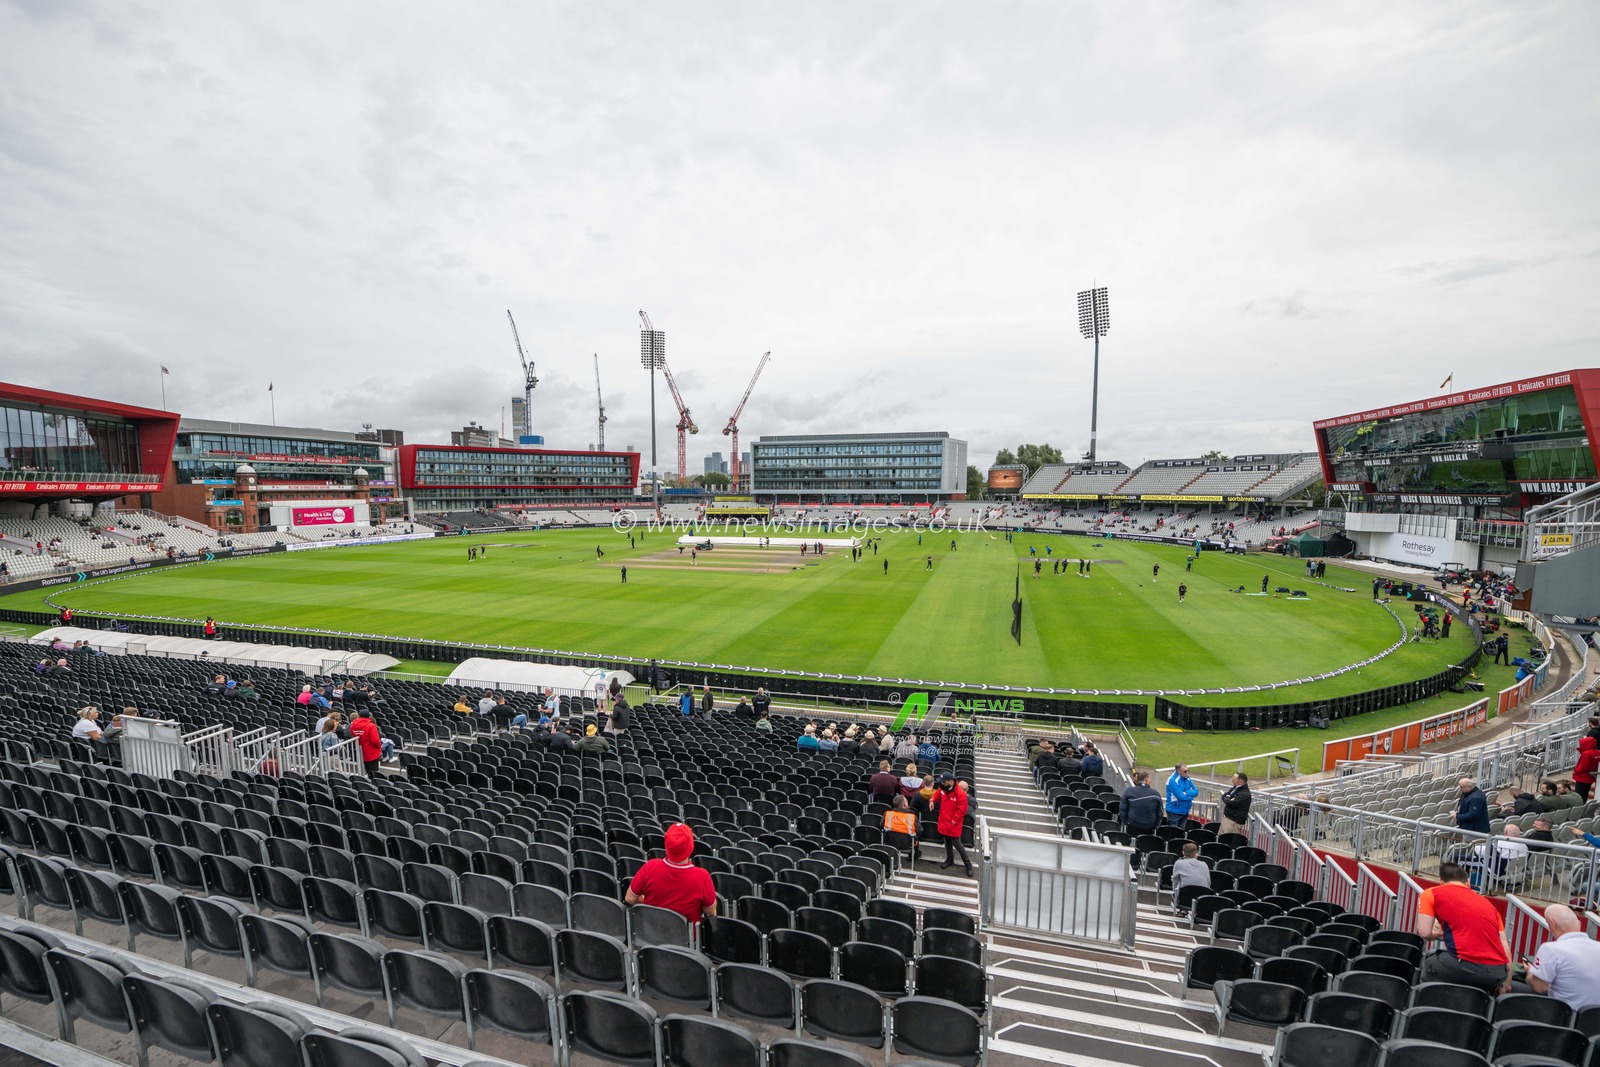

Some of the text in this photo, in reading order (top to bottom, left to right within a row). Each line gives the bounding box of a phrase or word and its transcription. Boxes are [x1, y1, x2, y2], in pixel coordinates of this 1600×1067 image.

[1518, 380, 1544, 391] Emirates
[1555, 374, 1570, 384] BETTER
[1468, 391, 1491, 400] Emirates
[1500, 386, 1512, 395] BETTER
[1433, 496, 1462, 504] GREATNESS
[1402, 541, 1435, 553] Rothesay
[109, 566, 121, 575] largest
[42, 576, 71, 586] Rothesay
